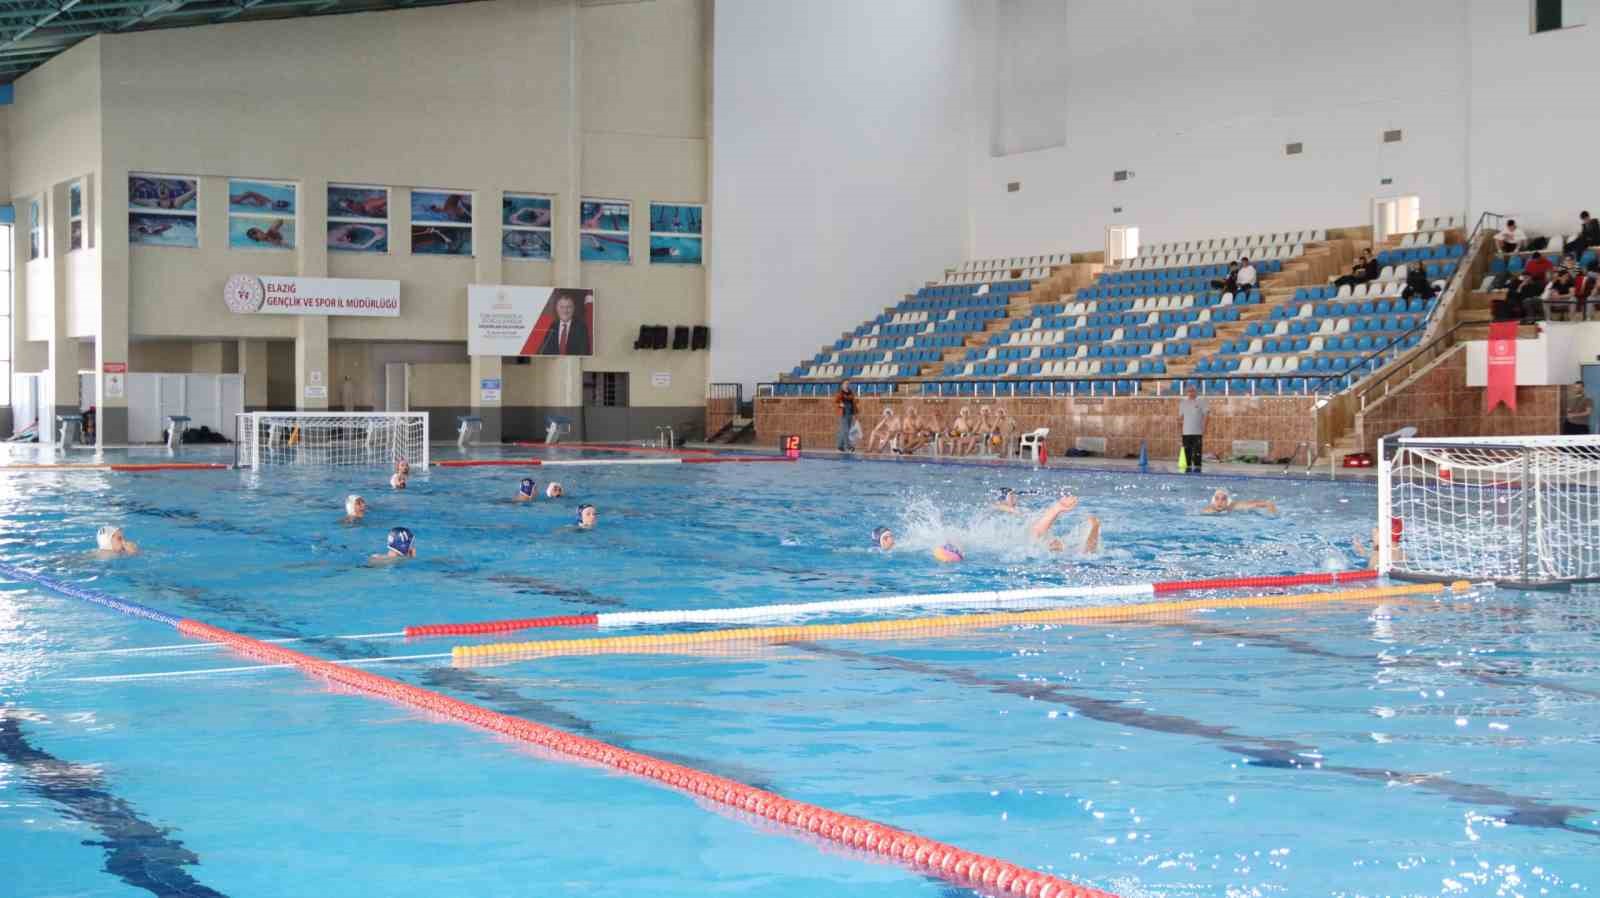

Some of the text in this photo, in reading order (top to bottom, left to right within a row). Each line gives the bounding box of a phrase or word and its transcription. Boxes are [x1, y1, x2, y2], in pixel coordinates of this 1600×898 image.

[267, 283, 297, 294] ELAZIĞ
[267, 296, 301, 308] GENÇLİK
[303, 298, 313, 307] VE
[315, 298, 336, 308] SPOR
[346, 297, 398, 309] MÜDÜRLÜĞÜ
[786, 436, 800, 449] 12
